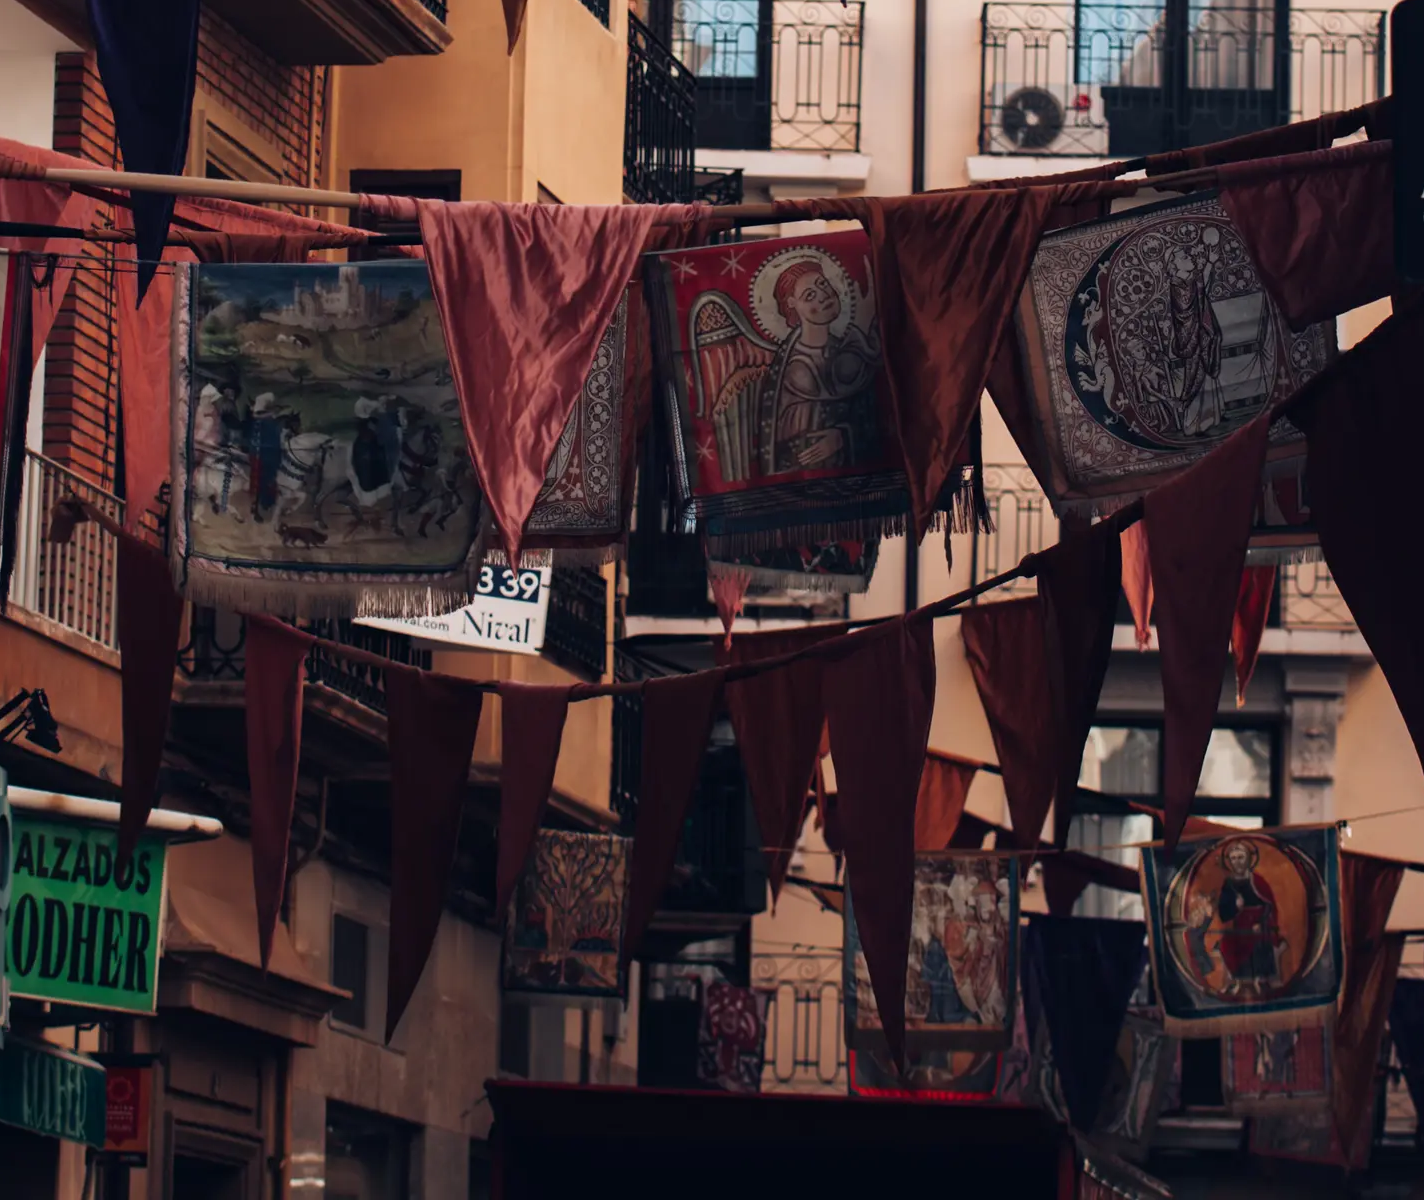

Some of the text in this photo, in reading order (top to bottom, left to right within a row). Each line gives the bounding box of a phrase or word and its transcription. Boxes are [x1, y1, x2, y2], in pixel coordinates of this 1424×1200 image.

[499, 569, 539, 600] 39
[462, 609, 532, 644] Nival
[5, 893, 151, 994] ODHER
